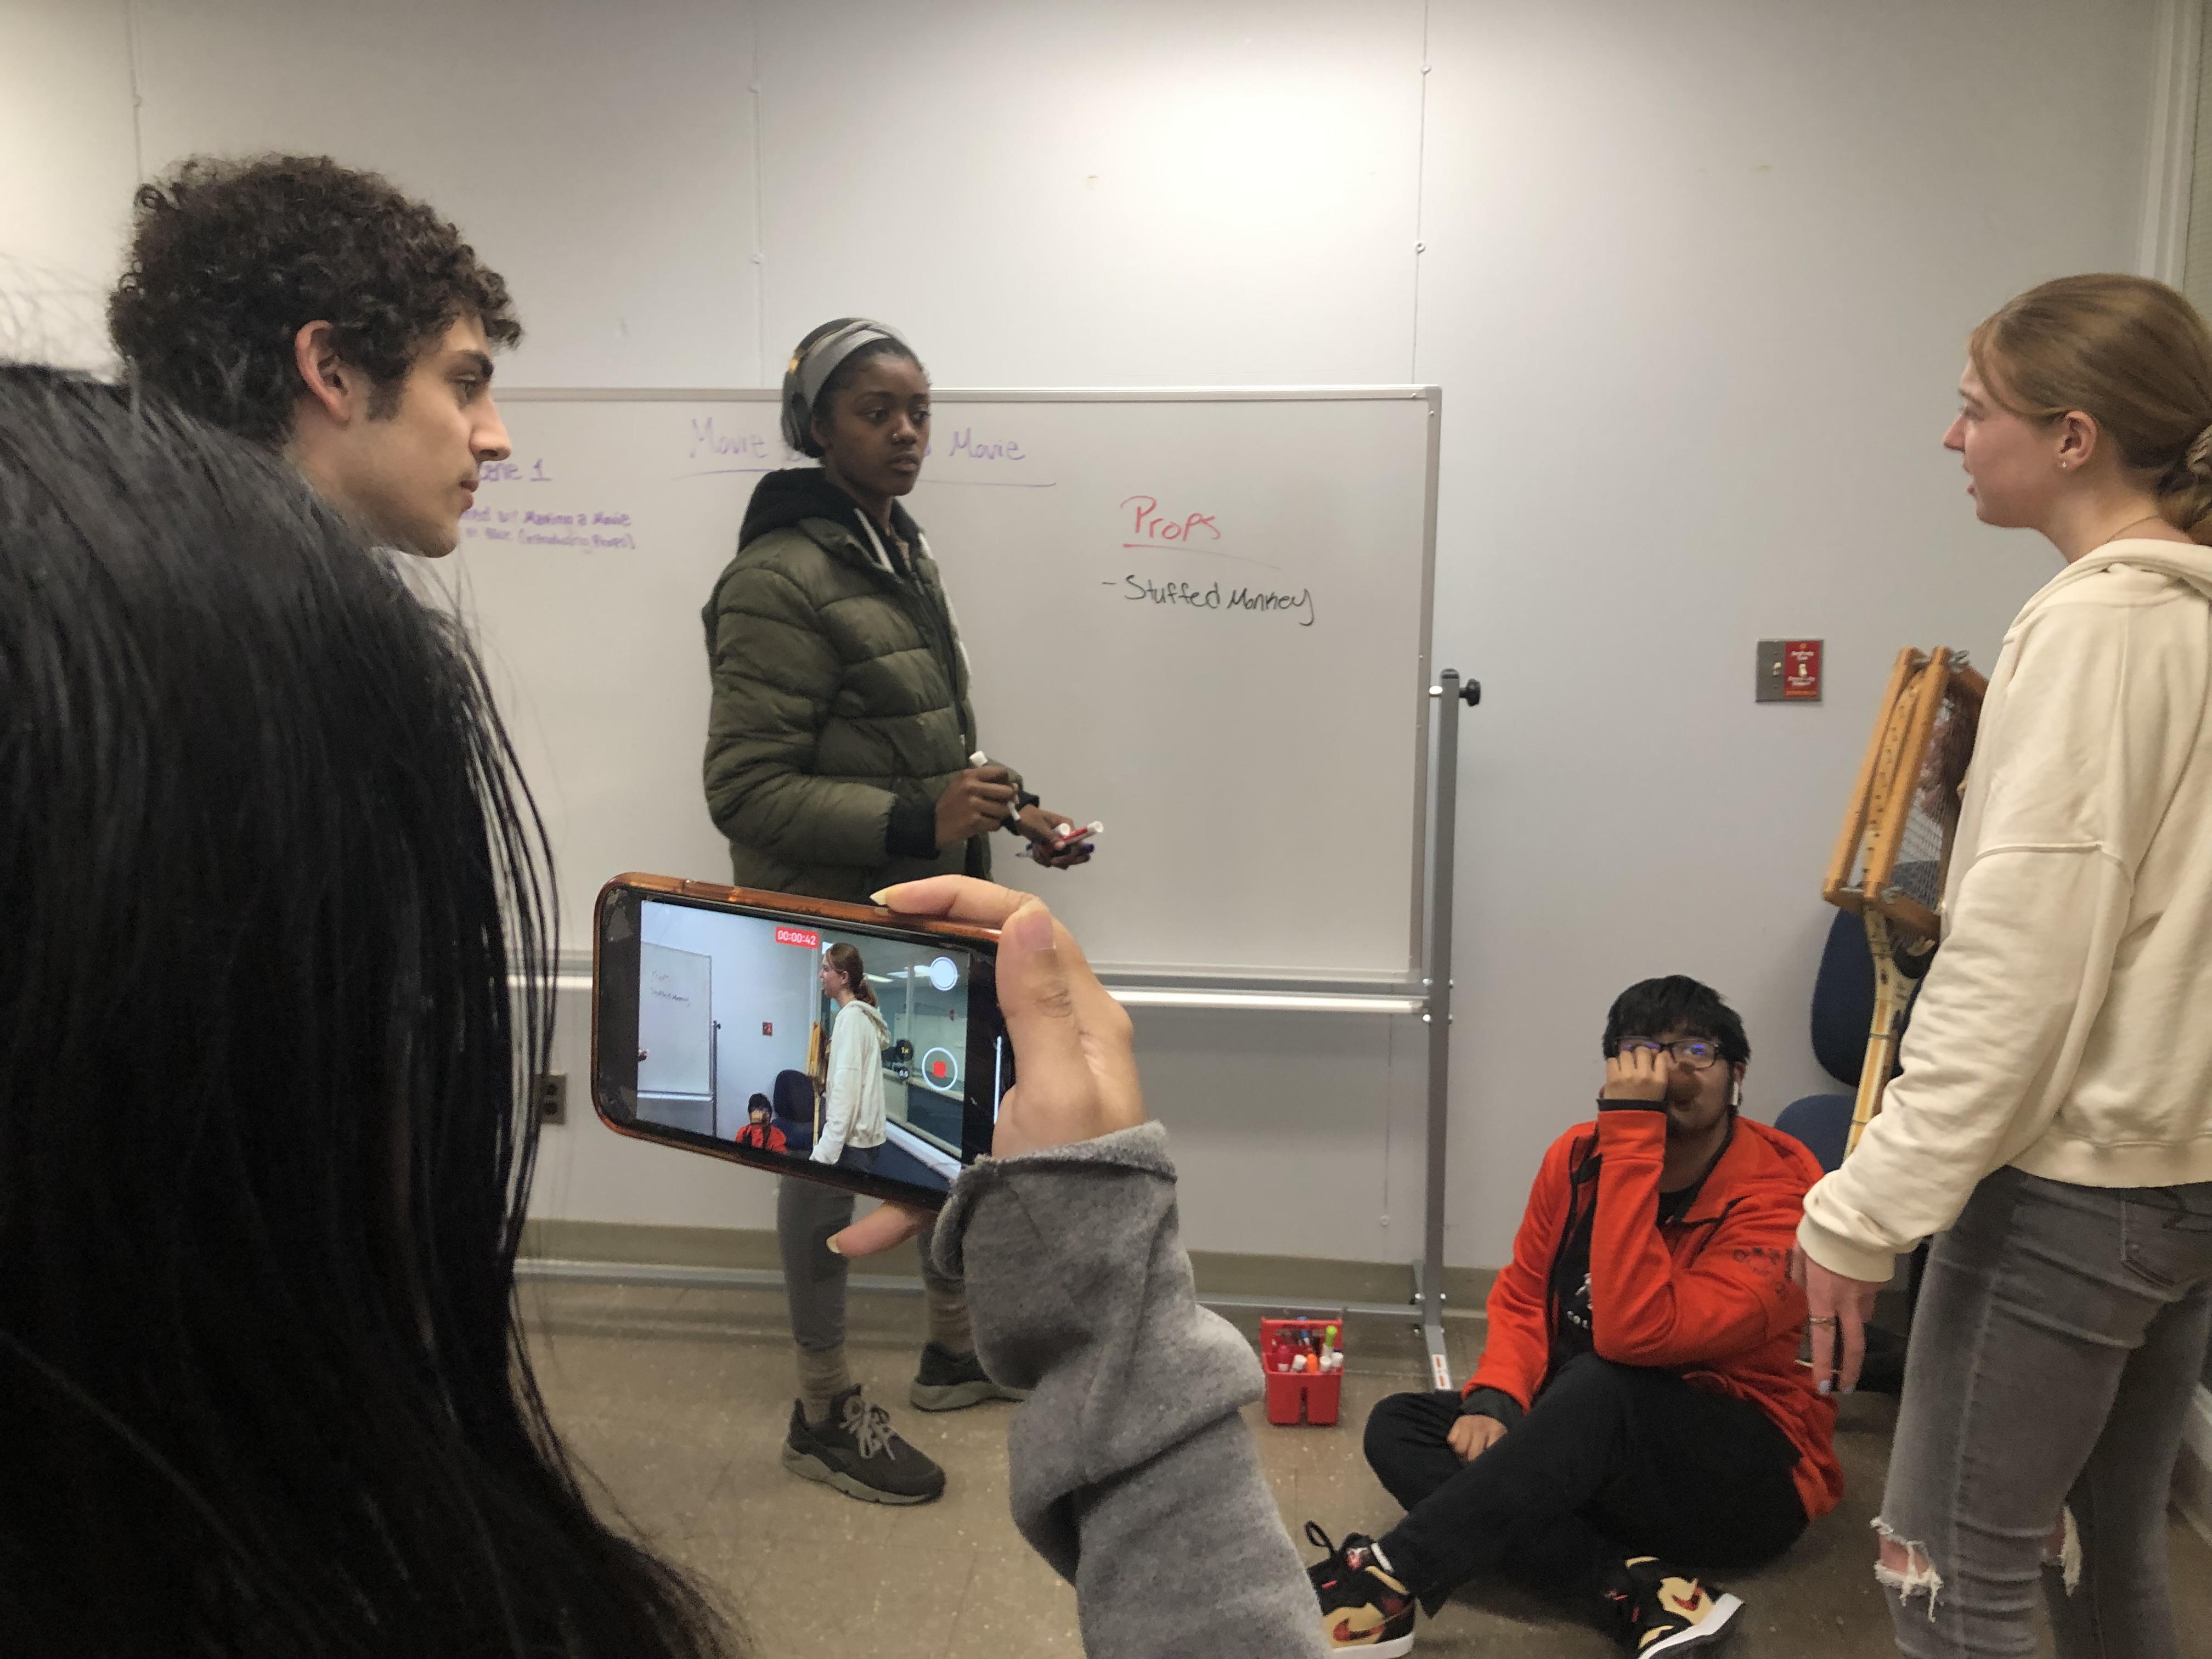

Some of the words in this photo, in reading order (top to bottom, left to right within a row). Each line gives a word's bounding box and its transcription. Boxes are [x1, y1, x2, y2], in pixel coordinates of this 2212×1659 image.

[948, 427, 1026, 461] Movie
[1120, 495, 1221, 542] Props
[1124, 574, 1221, 609] Stuffed
[777, 929, 817, 946] 00:00:42
